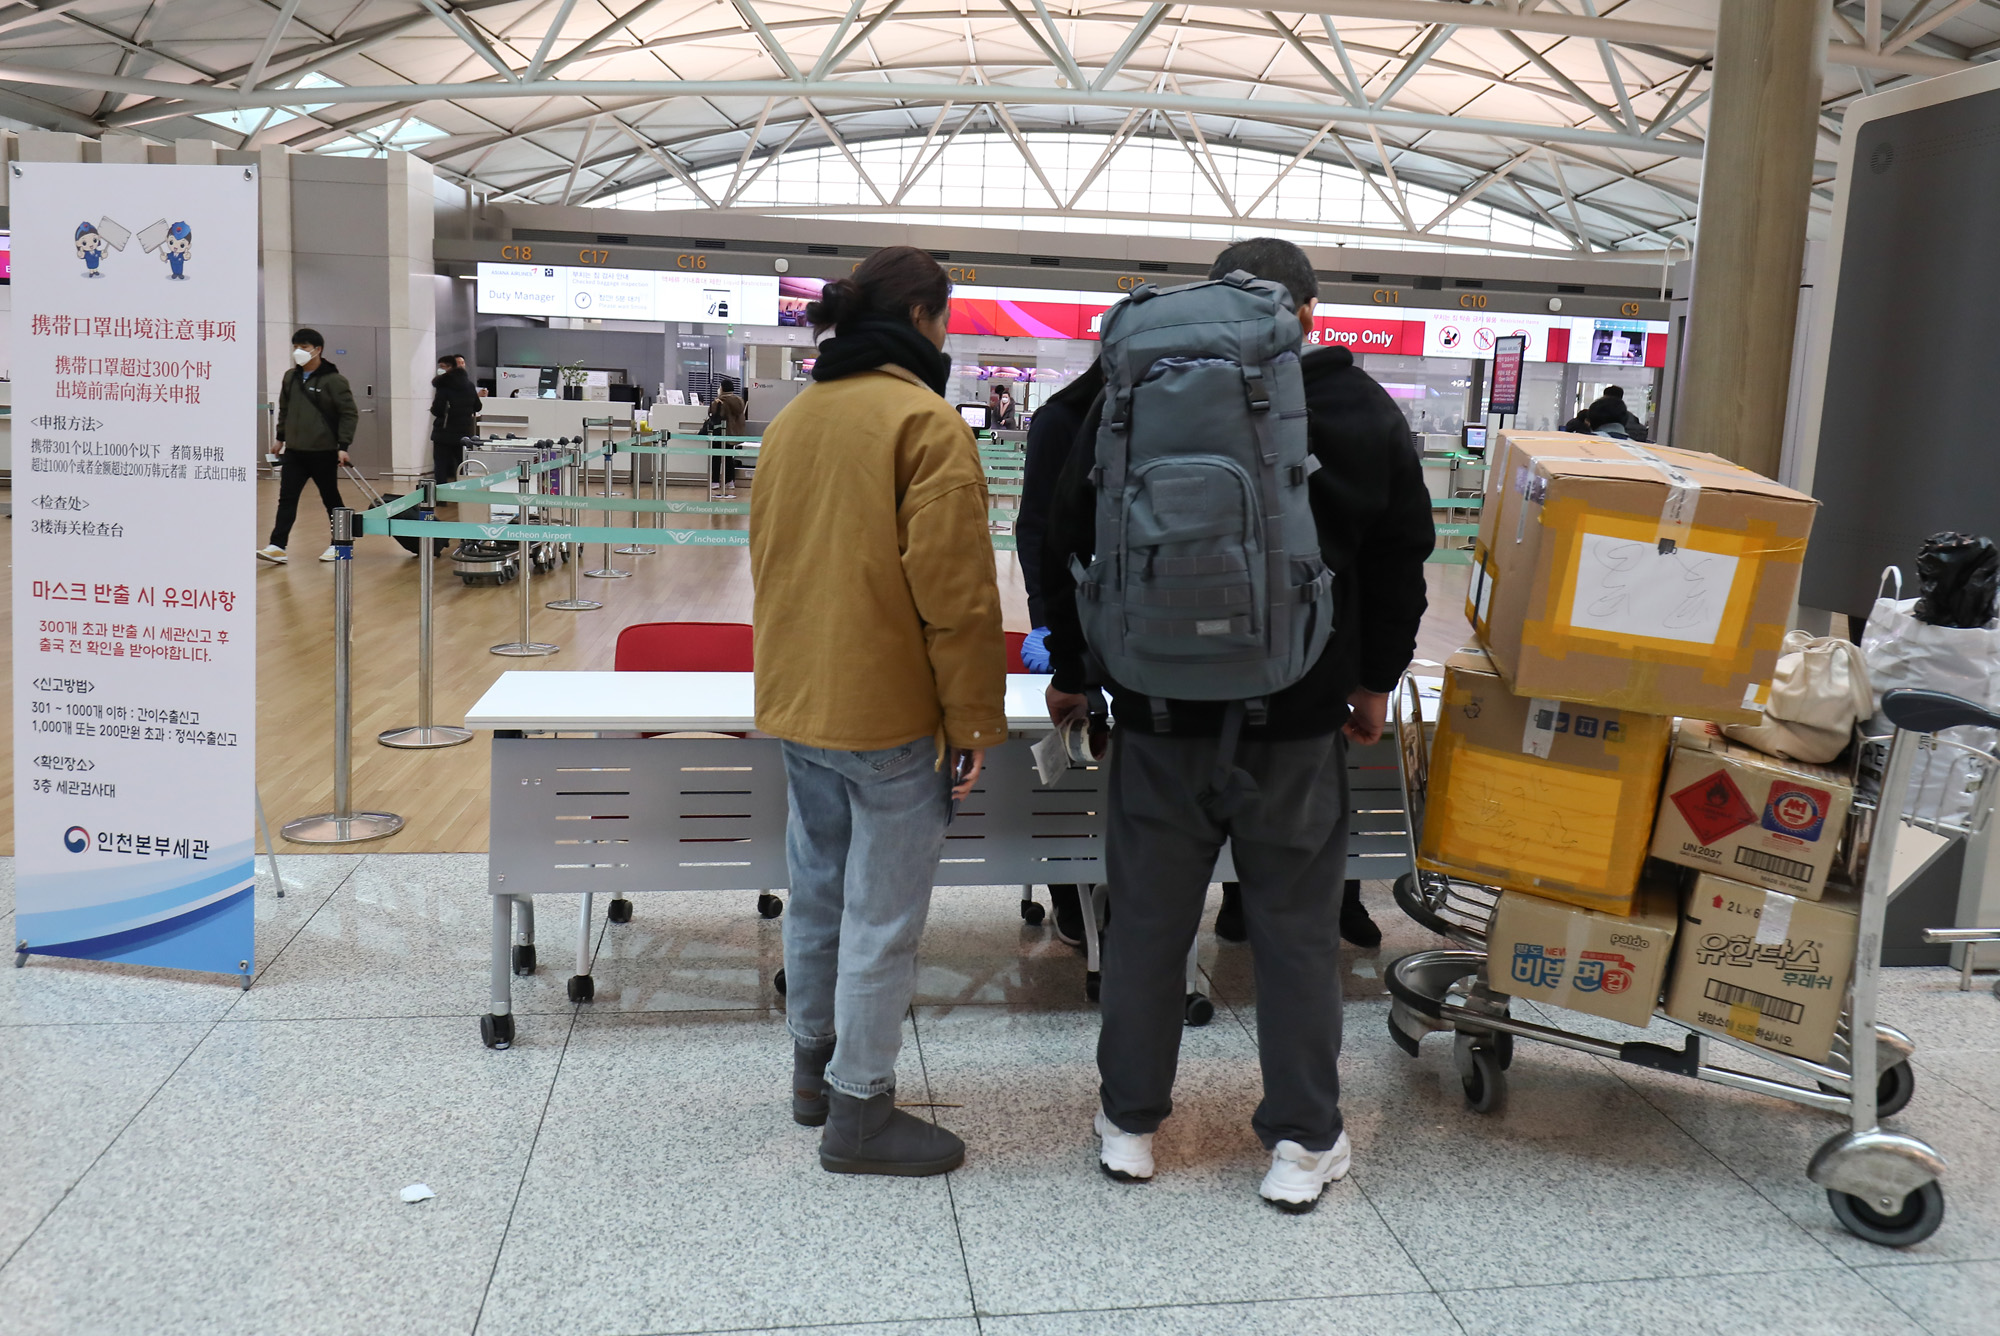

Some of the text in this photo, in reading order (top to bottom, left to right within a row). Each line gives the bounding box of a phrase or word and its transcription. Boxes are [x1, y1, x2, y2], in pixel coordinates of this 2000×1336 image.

[501, 245, 533, 261] C18
[579, 249, 609, 264] C17
[677, 254, 707, 269] C16
[948, 267, 976, 282] C14
[489, 290, 555, 303] Duty Manager
[1373, 290, 1400, 304] C11
[1460, 294, 1487, 309] C10
[1621, 302, 1640, 316] C9
[31, 313, 237, 342] 携带口罩出境注意事项
[1324, 328, 1358, 346] Drop
[1361, 329, 1394, 348] Only
[55, 355, 212, 380] 携带口罩超过300个时
[56, 380, 201, 405] 出境前需向海关申报
[30, 415, 104, 432] <申报方法>
[31, 438, 225, 462] 携带301个以上1000个以下 者简易申报
[194, 465, 247, 483] 正式出口申报
[31, 495, 90, 512] <检查处>
[31, 518, 125, 538] 3楼海关检查台
[507, 530, 571, 541] Incheon Airport
[1438, 527, 1459, 535] Airport
[694, 535, 749, 544] Incheon Airpo
[33, 580, 237, 613] 마스크 반출 시 유의사항
[39, 620, 230, 645] 300개 초과 반출 시 세관신고 후
[39, 637, 213, 663] 출국 전 확인을 받아야합니다.
[33, 677, 95, 694] <신고방법>
[31, 701, 51, 715] 301
[66, 703, 103, 720] 1000개
[106, 705, 128, 721] 이하
[137, 706, 201, 726] 간이수출신고
[32, 720, 73, 736] 1,000개
[75, 721, 96, 738] 또는
[99, 723, 141, 741] 200만원
[144, 726, 165, 743] 초과
[175, 728, 238, 748] 정식수출신고
[33, 755, 96, 772] <확인장소>
[33, 779, 116, 798] 3층 세관검사대
[97, 831, 210, 861] 인천본부세관
[1682, 842, 1722, 859] UN 2037
[1610, 933, 1650, 949] paldo
[1781, 972, 1833, 990] 후레쉬
